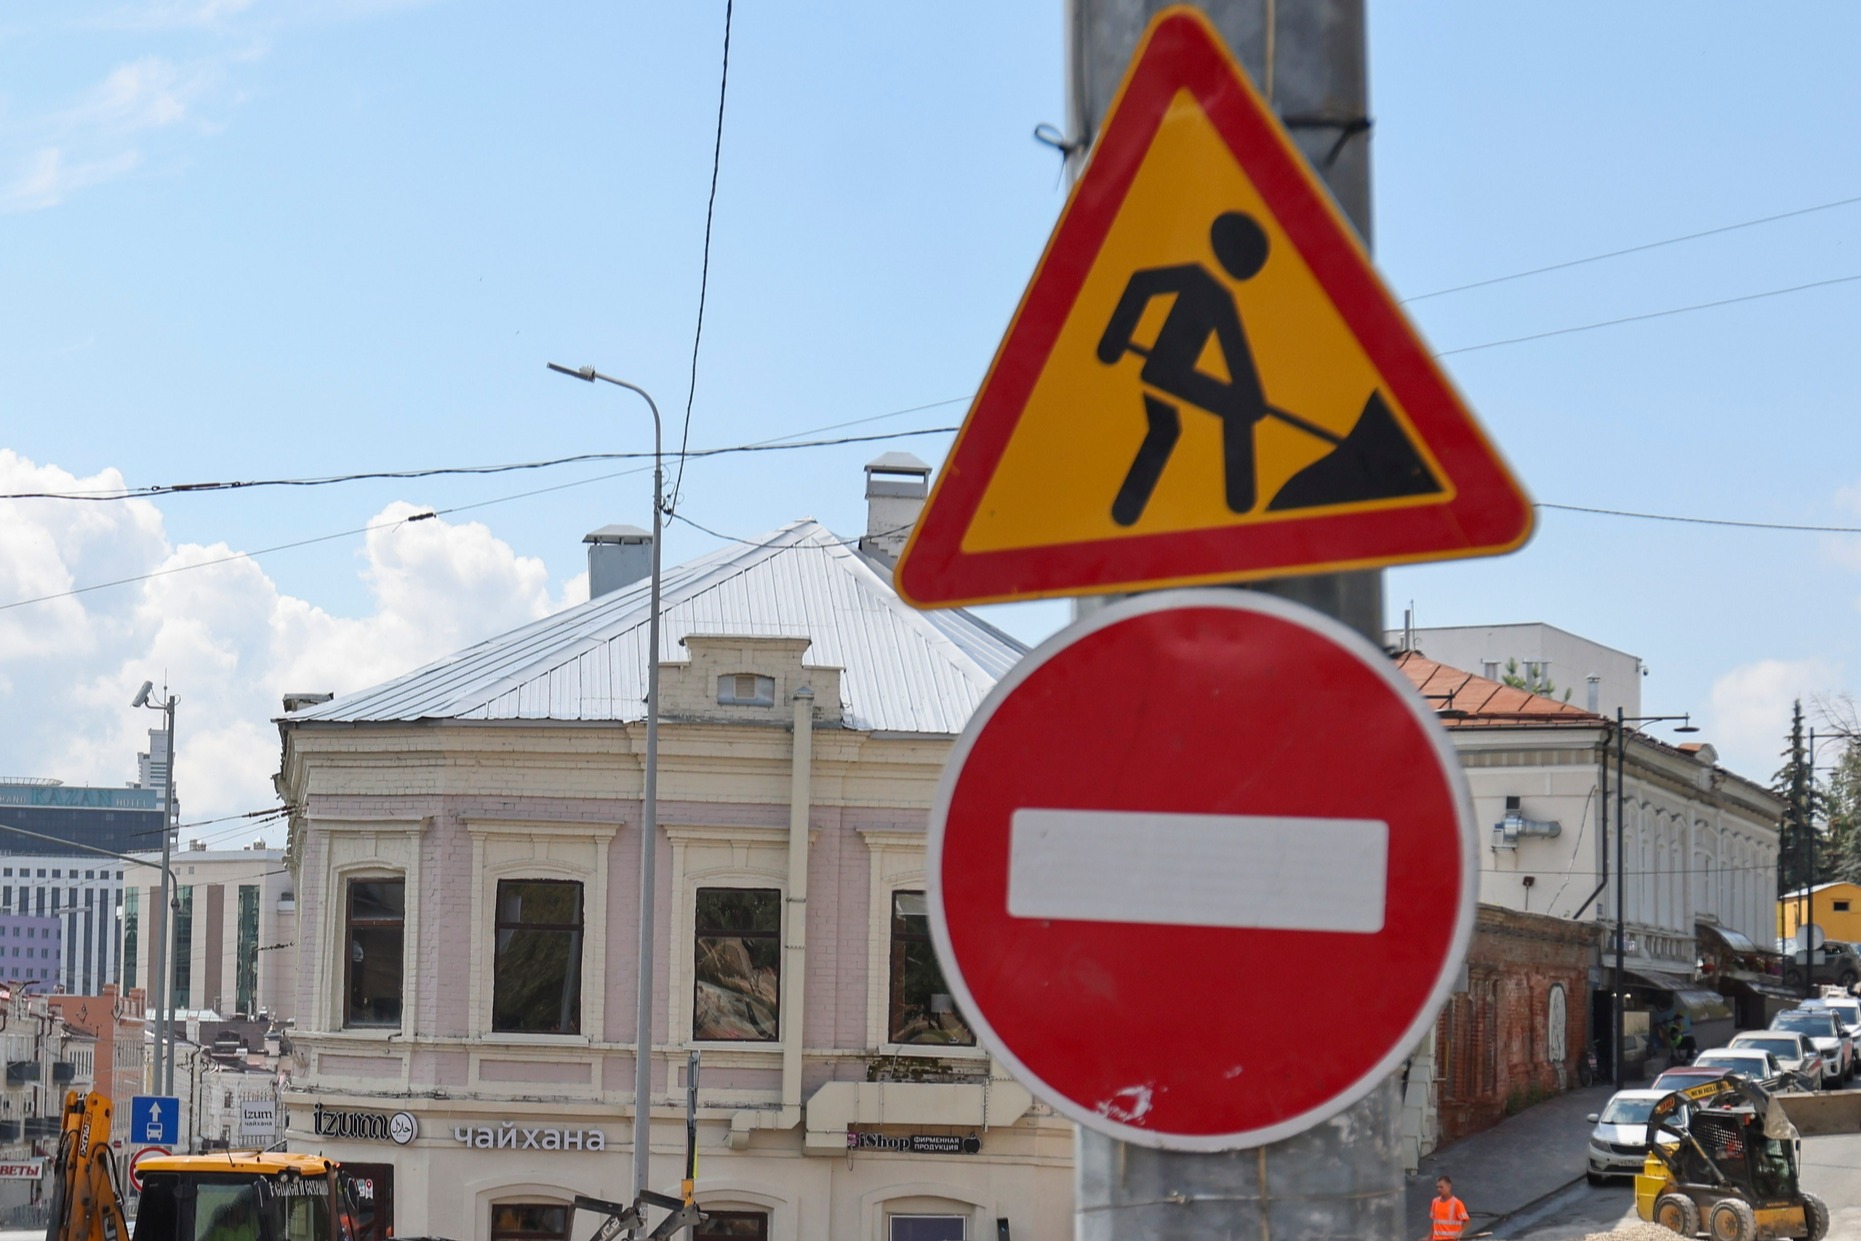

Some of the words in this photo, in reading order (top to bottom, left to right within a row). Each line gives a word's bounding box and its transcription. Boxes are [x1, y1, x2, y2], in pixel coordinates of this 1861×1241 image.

[31, 788, 112, 806] KAZAN
[116, 798, 147, 807] HOTEL
[244, 1108, 273, 1119] izum
[313, 1102, 390, 1141] izum
[454, 1121, 605, 1151] чайхана
[913, 1136, 960, 1144] ФИРМЕННАЯ
[914, 1143, 959, 1151] ПРОДУКЦИЯ
